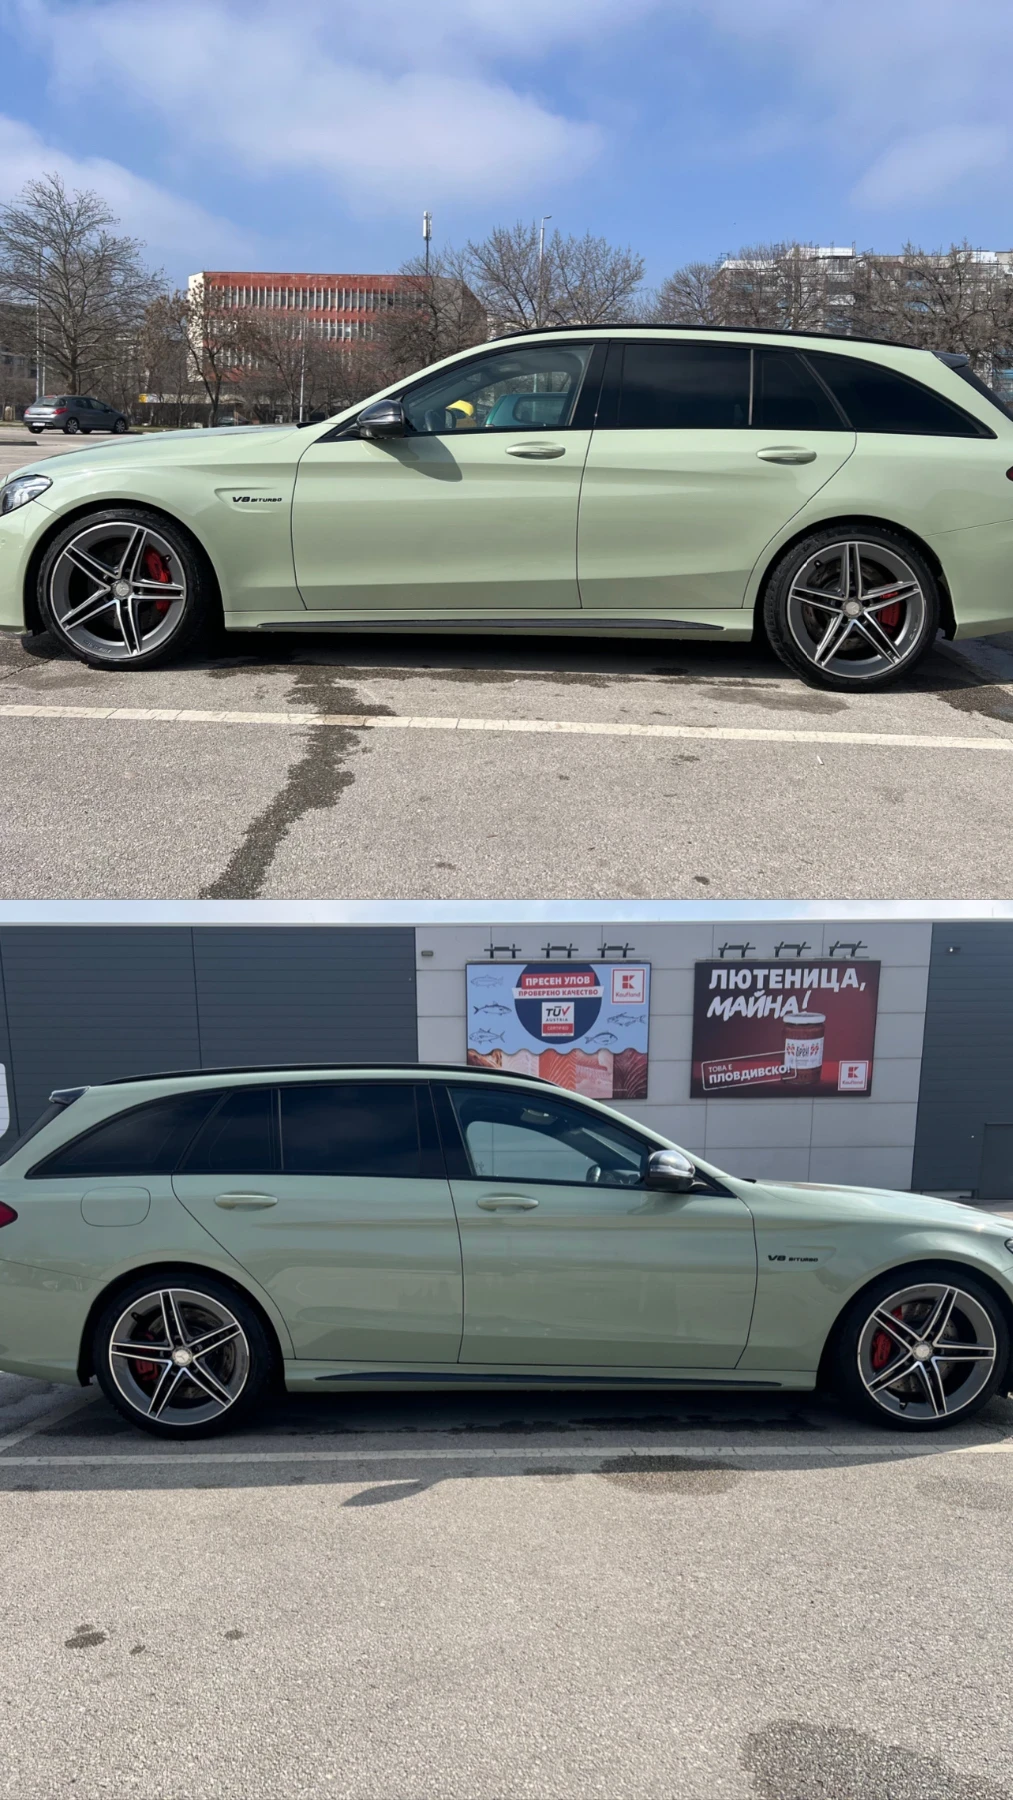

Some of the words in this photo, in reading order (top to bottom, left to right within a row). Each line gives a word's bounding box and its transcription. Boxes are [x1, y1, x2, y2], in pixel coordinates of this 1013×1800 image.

[525, 977, 562, 986] ПРЕСЕН
[564, 975, 590, 985] УЛОВ
[709, 968, 866, 993] ЛЮТЕНИЦА,
[518, 989, 561, 997] ПРОВЕРЕНО
[562, 988, 598, 996] КАЧЕСТВО
[545, 1005, 571, 1017] TÜV
[706, 990, 812, 1021] МАЙНА!
[708, 1065, 727, 1073] ТОВА
[709, 1064, 791, 1084] ПЛОВДИВСКО!
